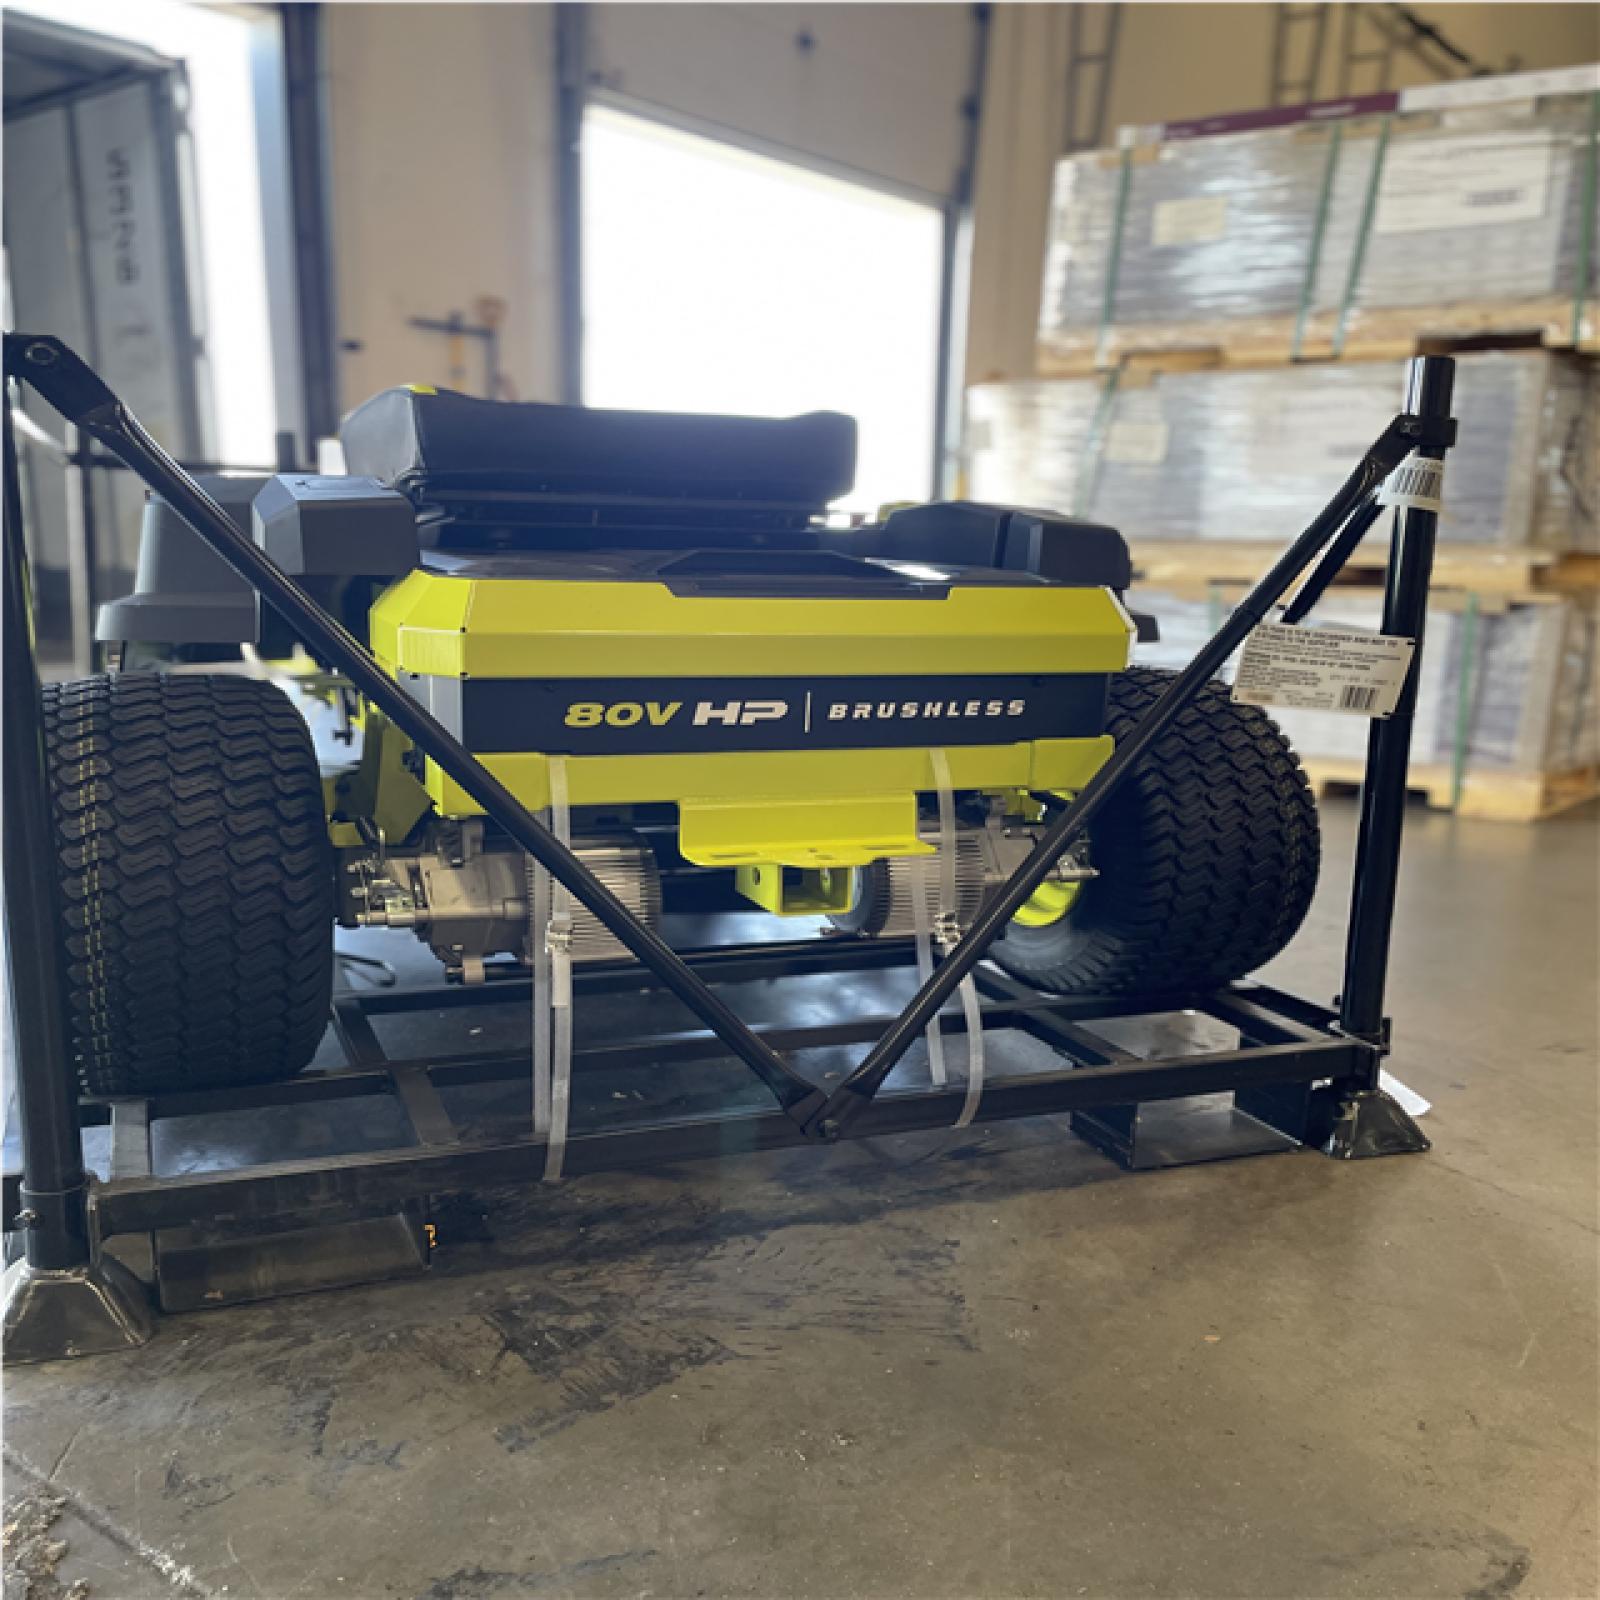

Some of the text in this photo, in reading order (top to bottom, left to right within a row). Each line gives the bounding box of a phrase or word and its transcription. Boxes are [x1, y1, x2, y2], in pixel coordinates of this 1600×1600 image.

[564, 700, 1026, 727] 80V HP BRUSHLESS
